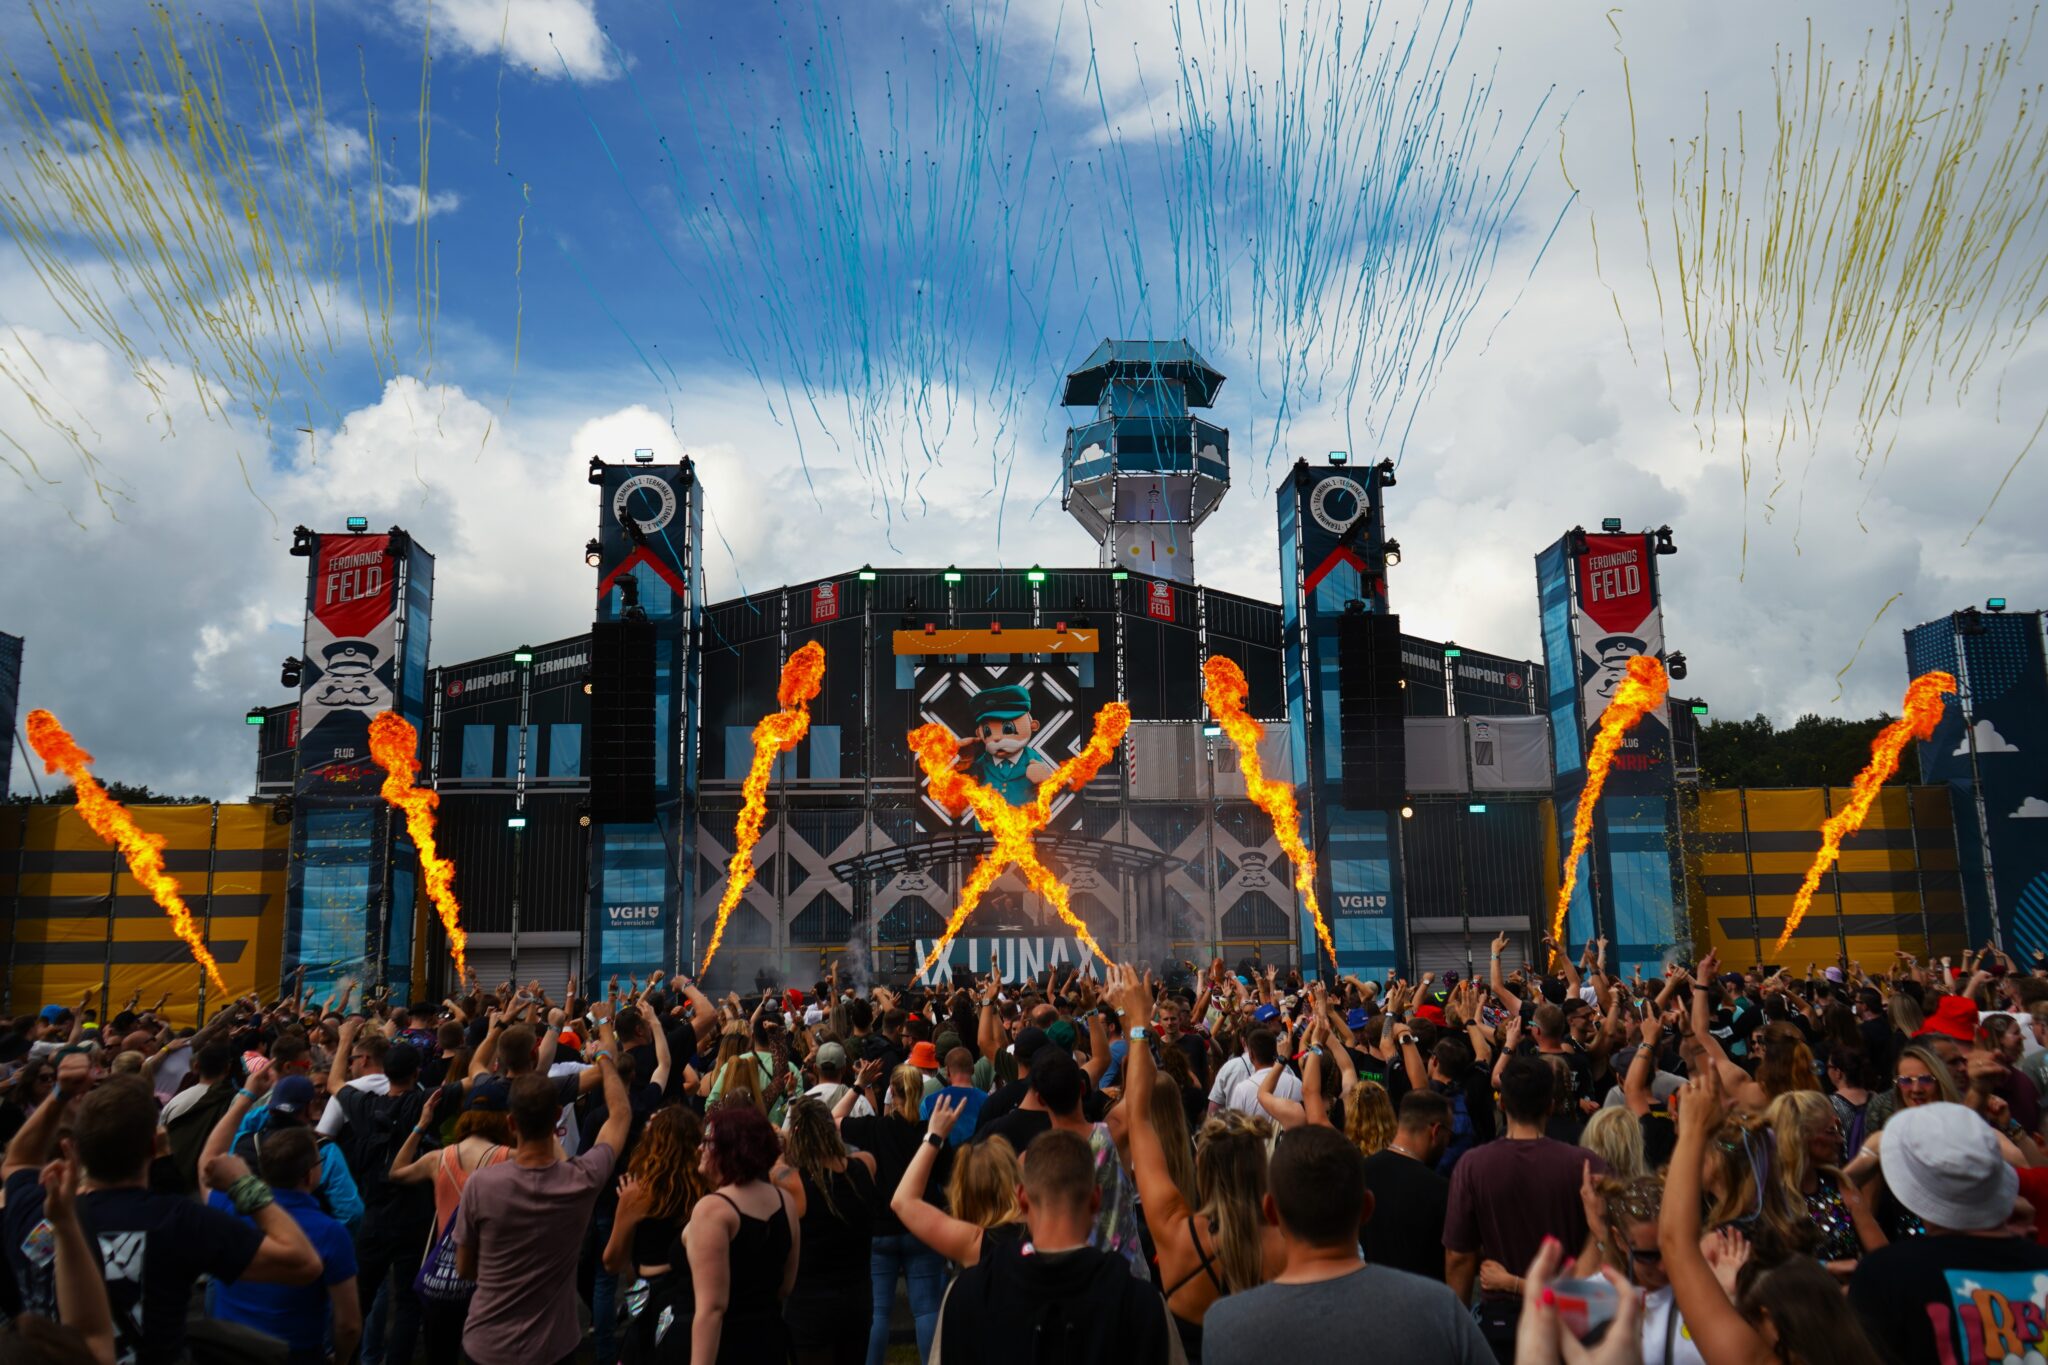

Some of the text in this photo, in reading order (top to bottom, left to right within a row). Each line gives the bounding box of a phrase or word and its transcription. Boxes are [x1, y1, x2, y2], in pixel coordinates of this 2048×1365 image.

[328, 550, 383, 572] FERDINANDS
[1589, 549, 1638, 570] FERDINANDS
[326, 566, 382, 605] FELD
[1590, 565, 1641, 602] FELD
[815, 603, 836, 619] FELD
[1151, 602, 1171, 617] FELD
[464, 652, 588, 692] AIRPORT TERMINAL
[1401, 650, 1506, 685] RMINAL AIRPORT
[1621, 738, 1639, 748] FLUG
[333, 748, 354, 758] FLUG
[1338, 895, 1375, 908] VGH
[608, 906, 646, 919] VGH
